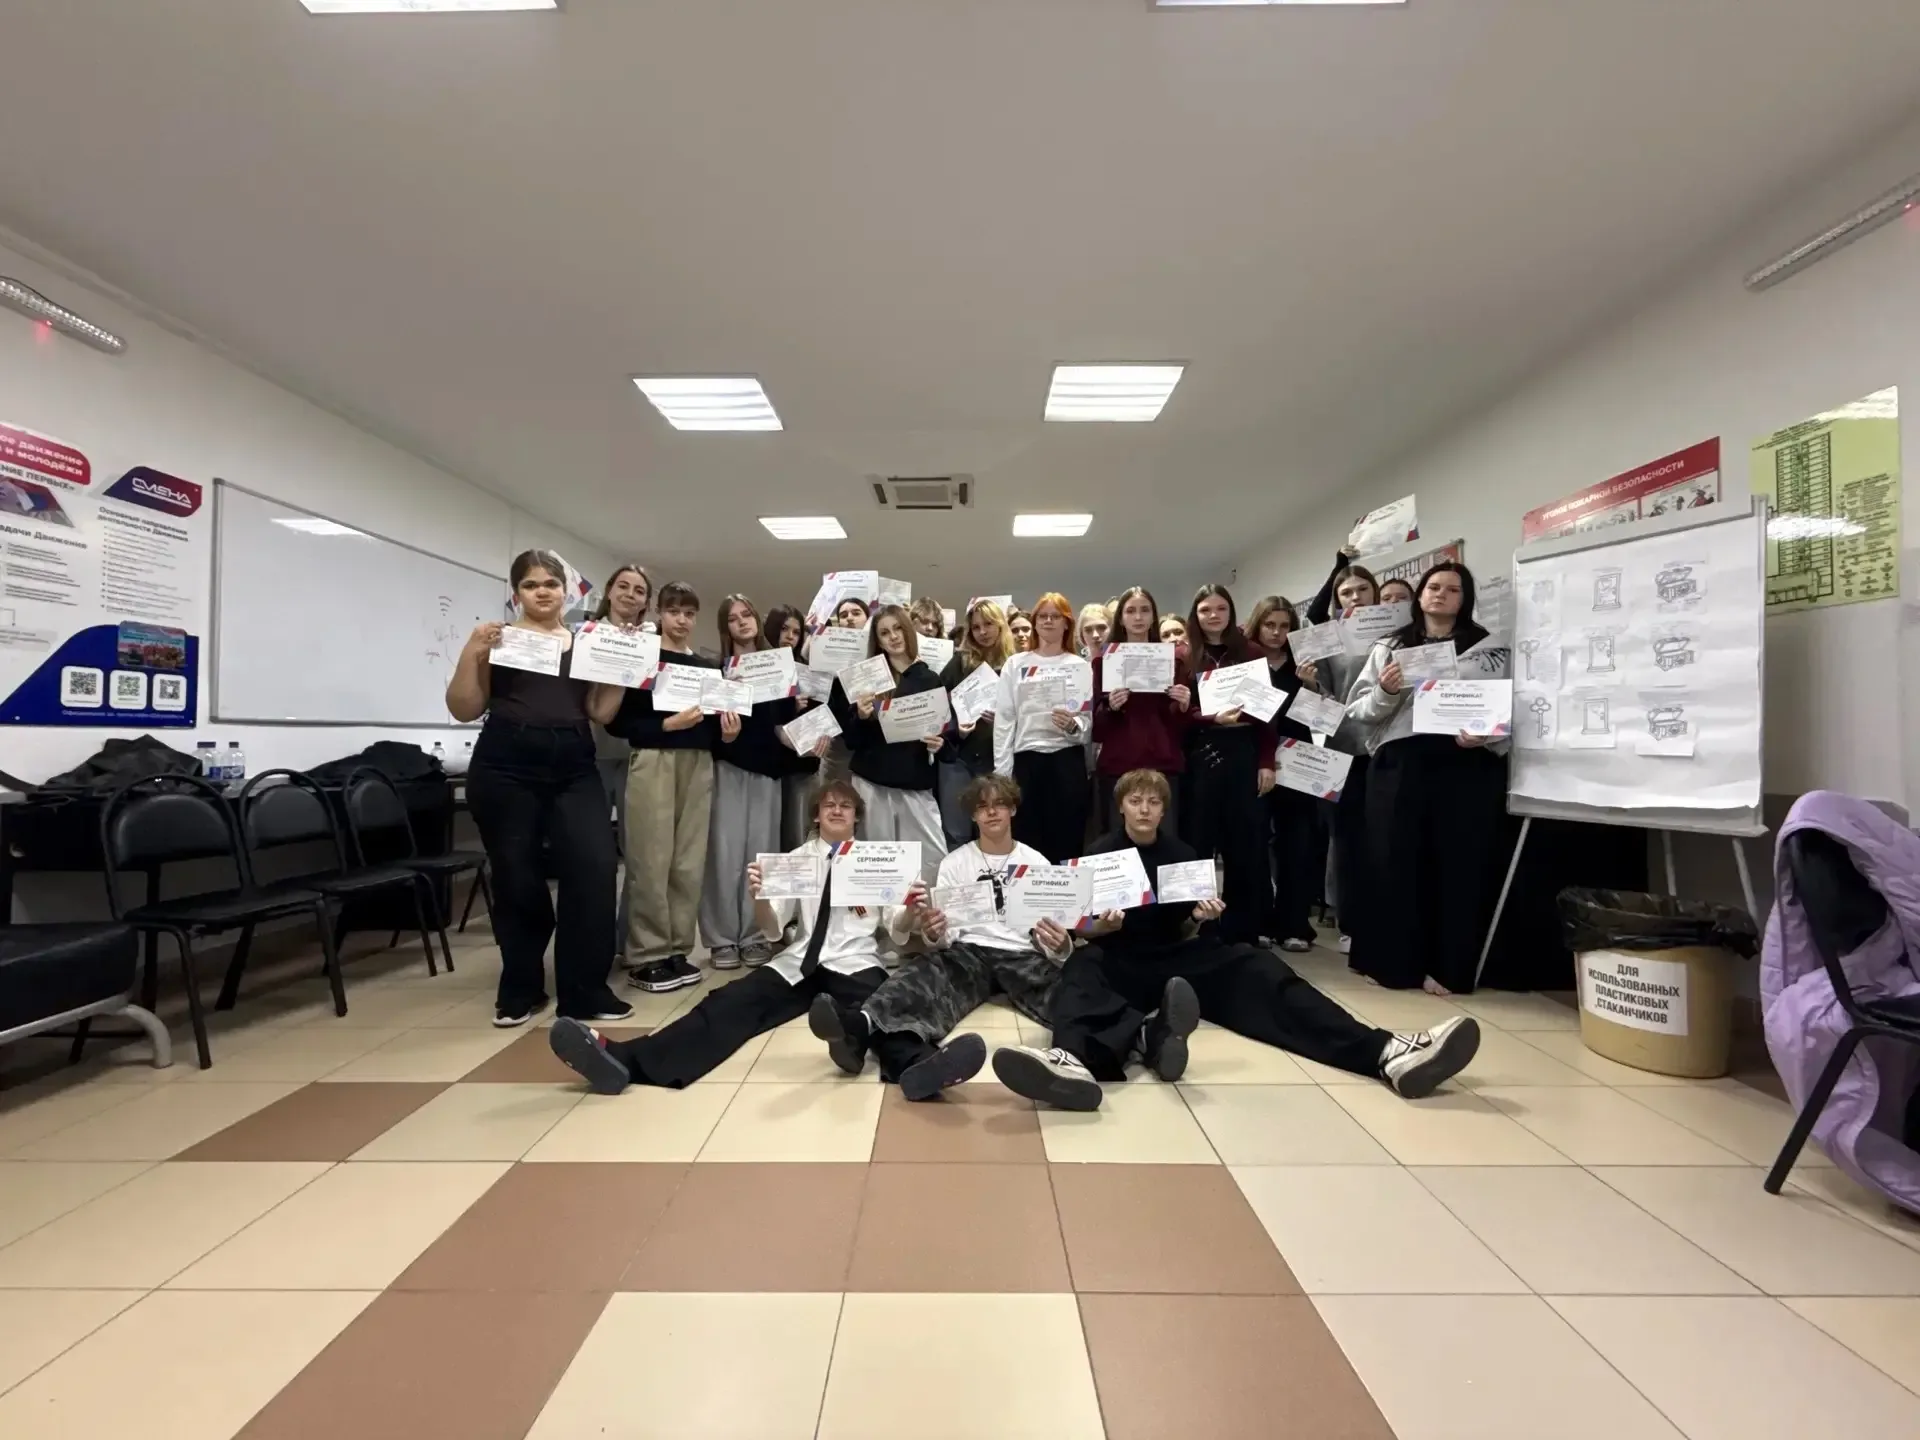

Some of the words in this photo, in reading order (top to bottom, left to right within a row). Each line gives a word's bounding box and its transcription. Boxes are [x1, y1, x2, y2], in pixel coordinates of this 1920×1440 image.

[1612, 459, 1685, 494] БЕЗОПАСНОСТИ
[1588, 967, 1680, 998] ИСПОЛЬЗОВАННЫХ
[1617, 964, 1639, 978] ДЛЯ
[1595, 983, 1669, 1010] ПЛАСТИКОВЫХ
